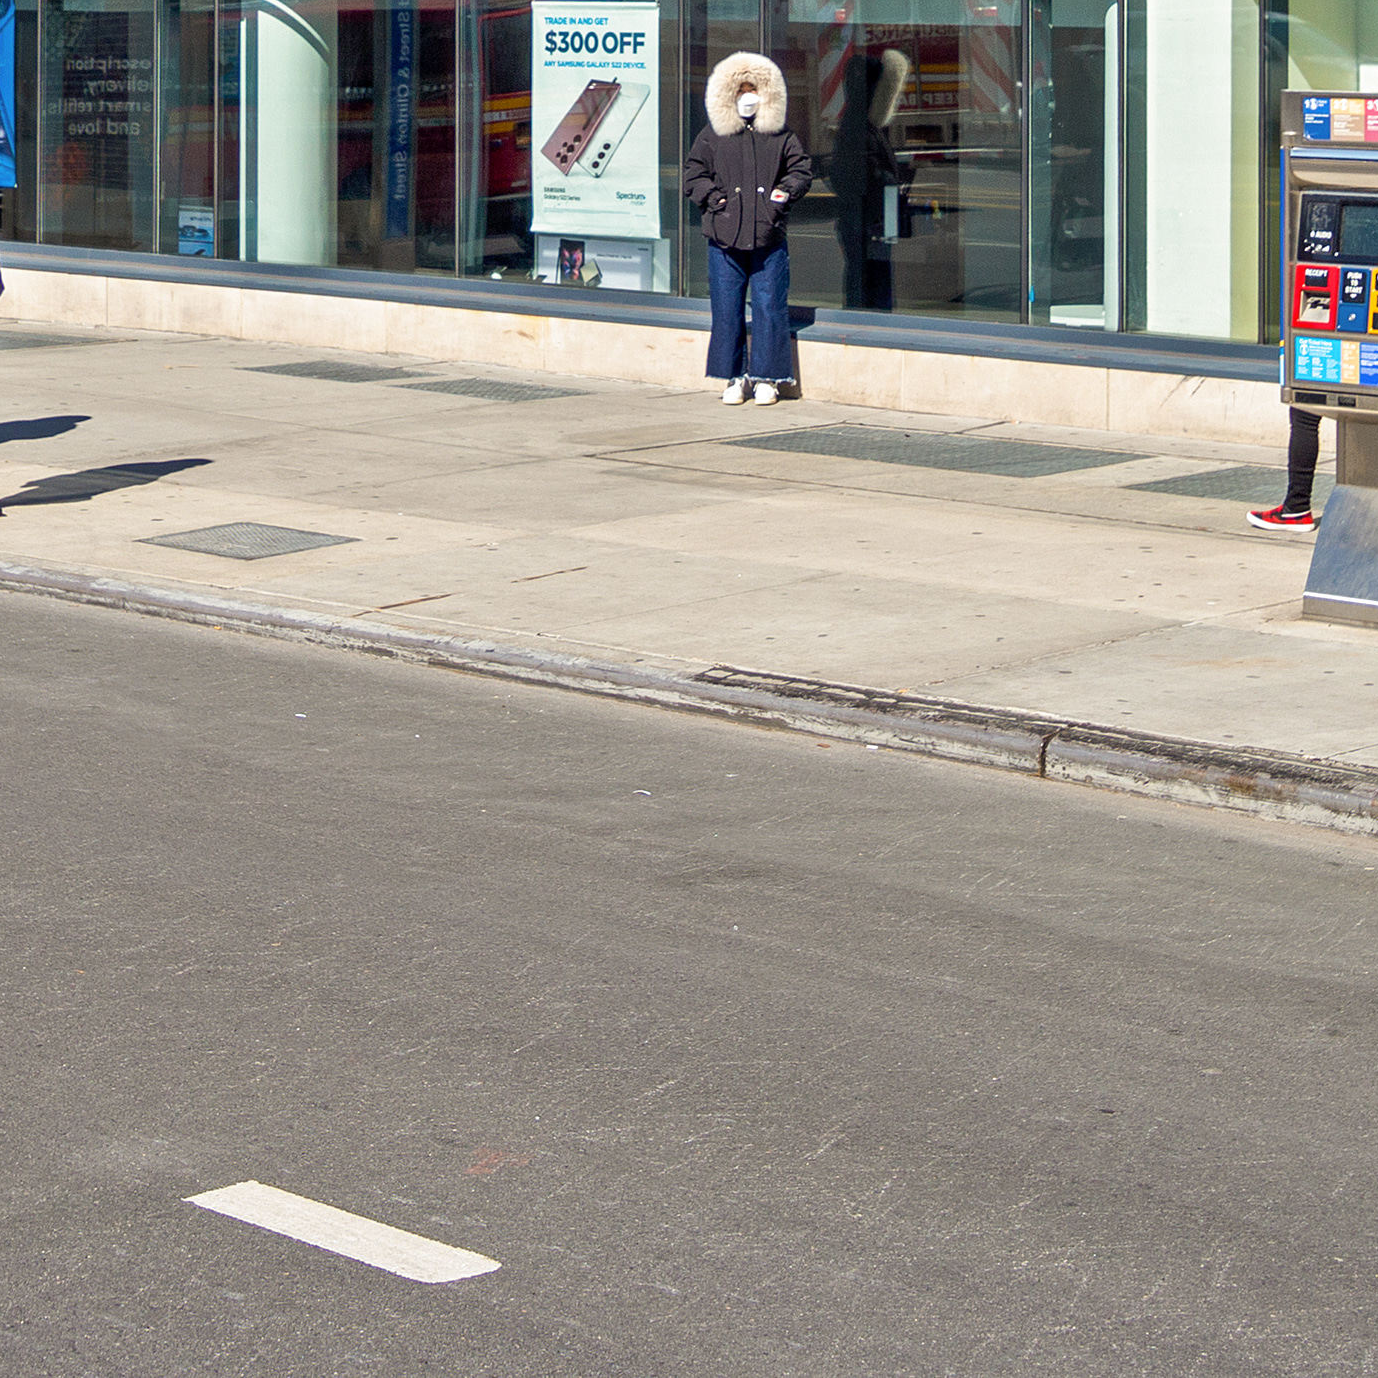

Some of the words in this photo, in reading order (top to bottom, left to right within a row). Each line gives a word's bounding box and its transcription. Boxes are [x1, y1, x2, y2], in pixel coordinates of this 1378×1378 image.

[544, 17, 567, 25] TRADE
[544, 29, 599, 56] $300
[602, 32, 646, 54] OFF
[616, 191, 643, 200] Spectrum
[1305, 268, 1328, 277] RECEIPT
[1347, 271, 1362, 280] PUSH
